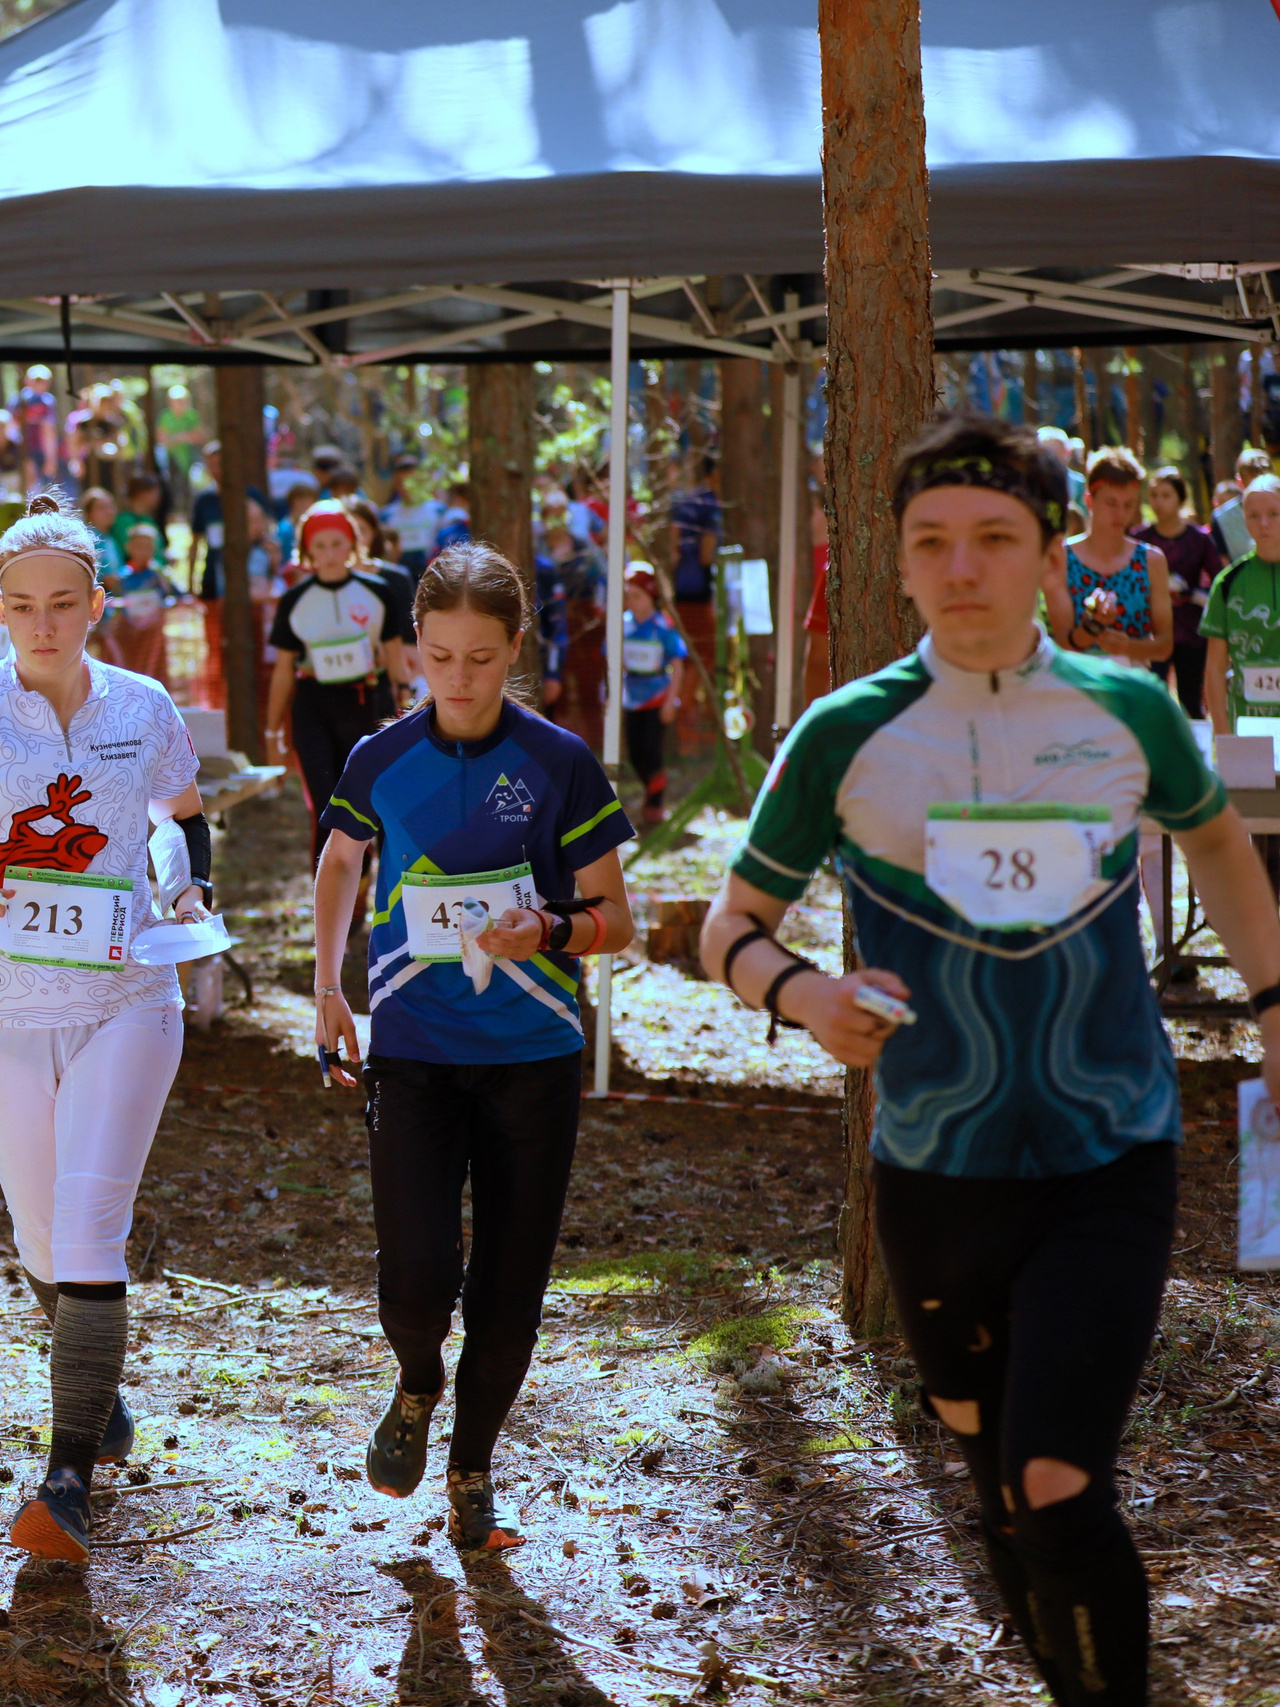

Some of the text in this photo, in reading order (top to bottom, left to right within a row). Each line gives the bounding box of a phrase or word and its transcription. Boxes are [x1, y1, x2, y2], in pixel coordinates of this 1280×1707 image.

[90, 739, 142, 752] Кузнеченкова
[100, 752, 136, 761] Елизавета
[500, 814, 528, 822] ТРОПА
[980, 848, 1035, 892] 28
[21, 901, 83, 936] 213
[110, 895, 120, 942] ПЕРМСКИЙ
[117, 907, 127, 943] ПЕРИОД
